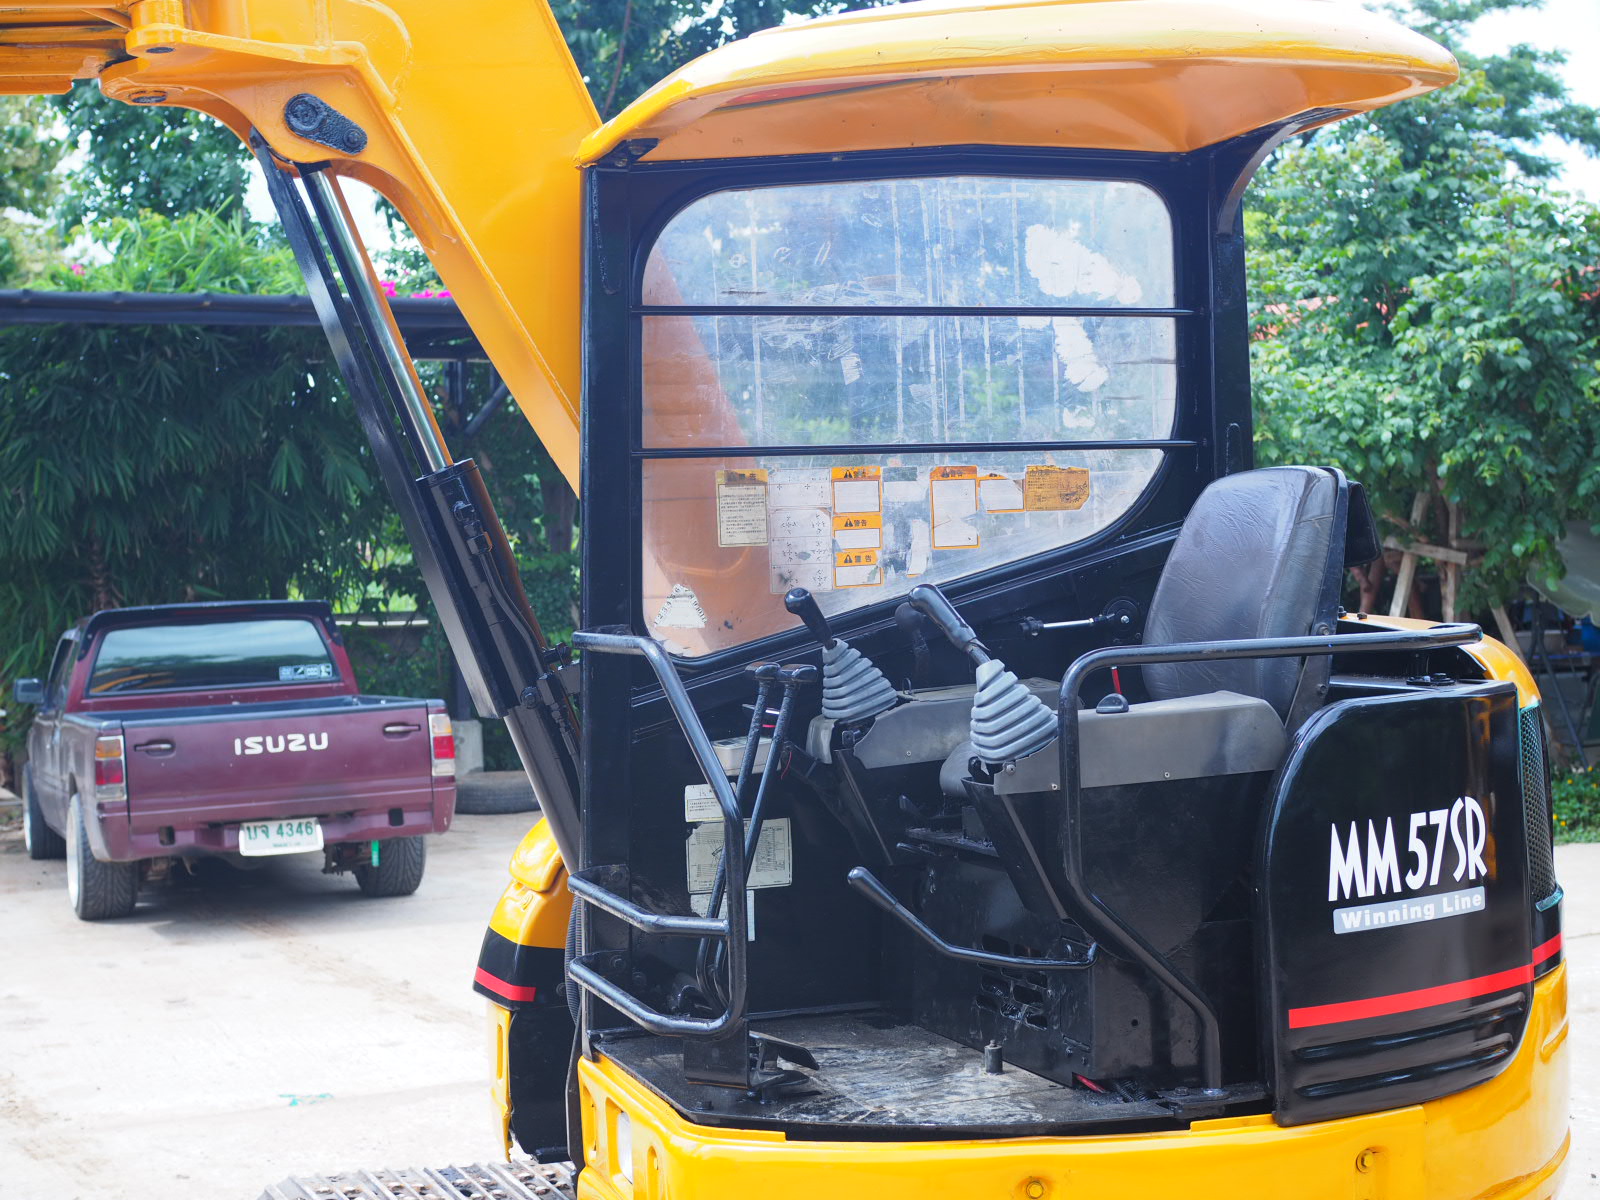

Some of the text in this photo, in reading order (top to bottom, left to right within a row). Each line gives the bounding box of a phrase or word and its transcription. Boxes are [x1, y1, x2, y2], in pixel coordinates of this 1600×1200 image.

[234, 731, 329, 756] ISUZU
[276, 821, 314, 838] 4346
[1328, 796, 1488, 902] MM 57SR
[1341, 892, 1482, 930] Winning Line
